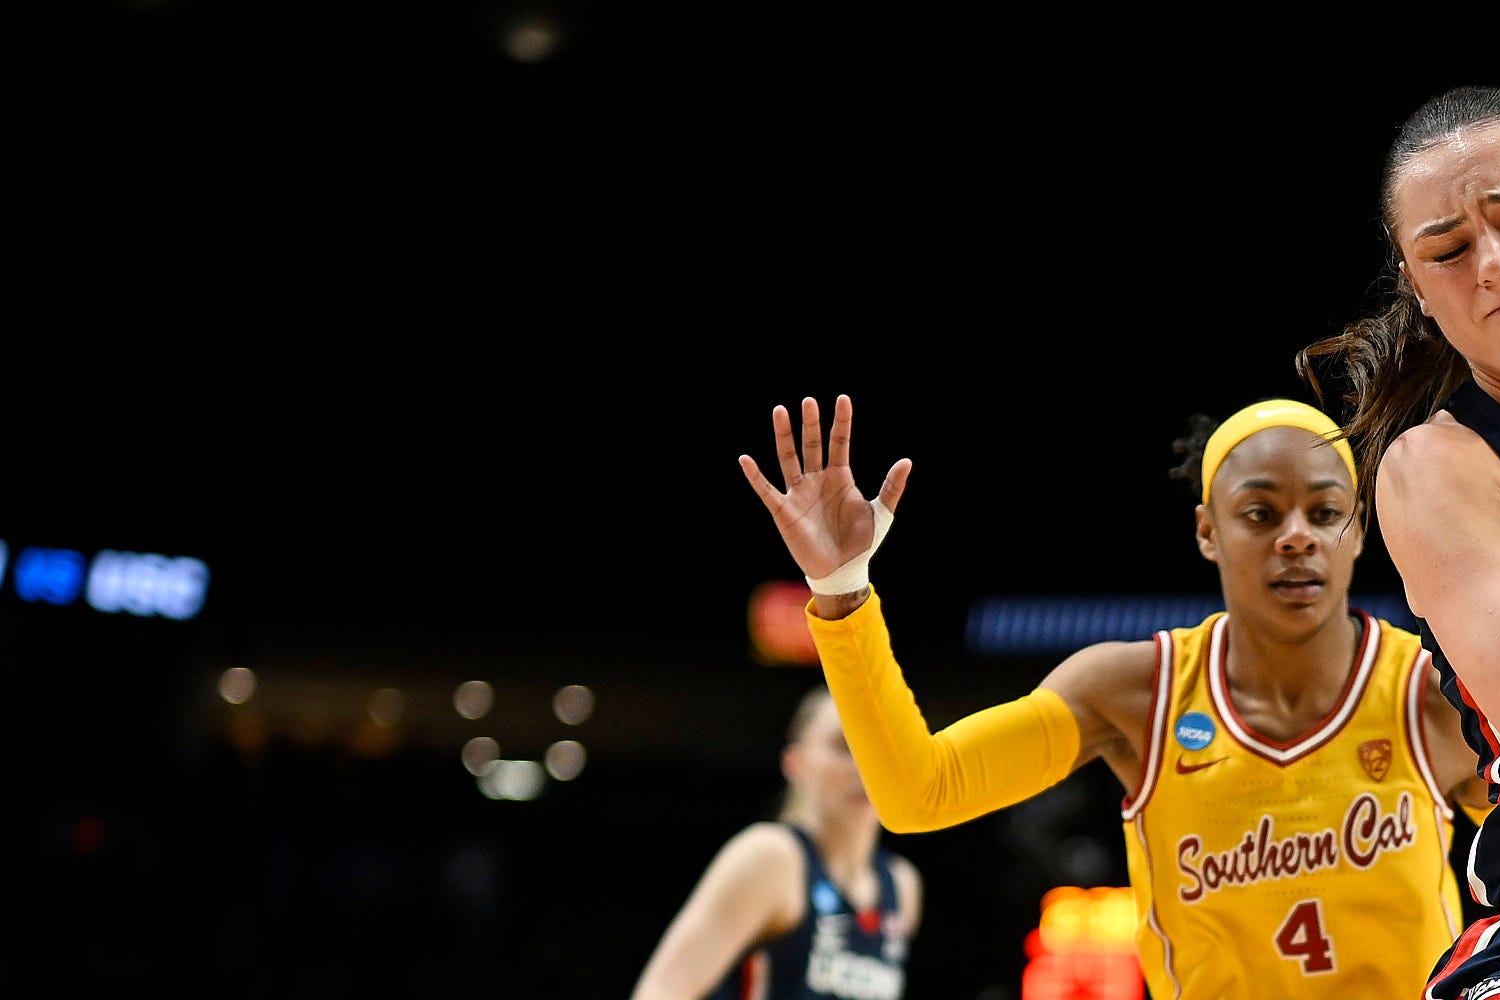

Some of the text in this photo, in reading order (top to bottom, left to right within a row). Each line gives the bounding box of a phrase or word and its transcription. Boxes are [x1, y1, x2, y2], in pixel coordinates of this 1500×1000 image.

[1178, 790, 1415, 904] Southern Cal
[1274, 898, 1338, 977] 4
